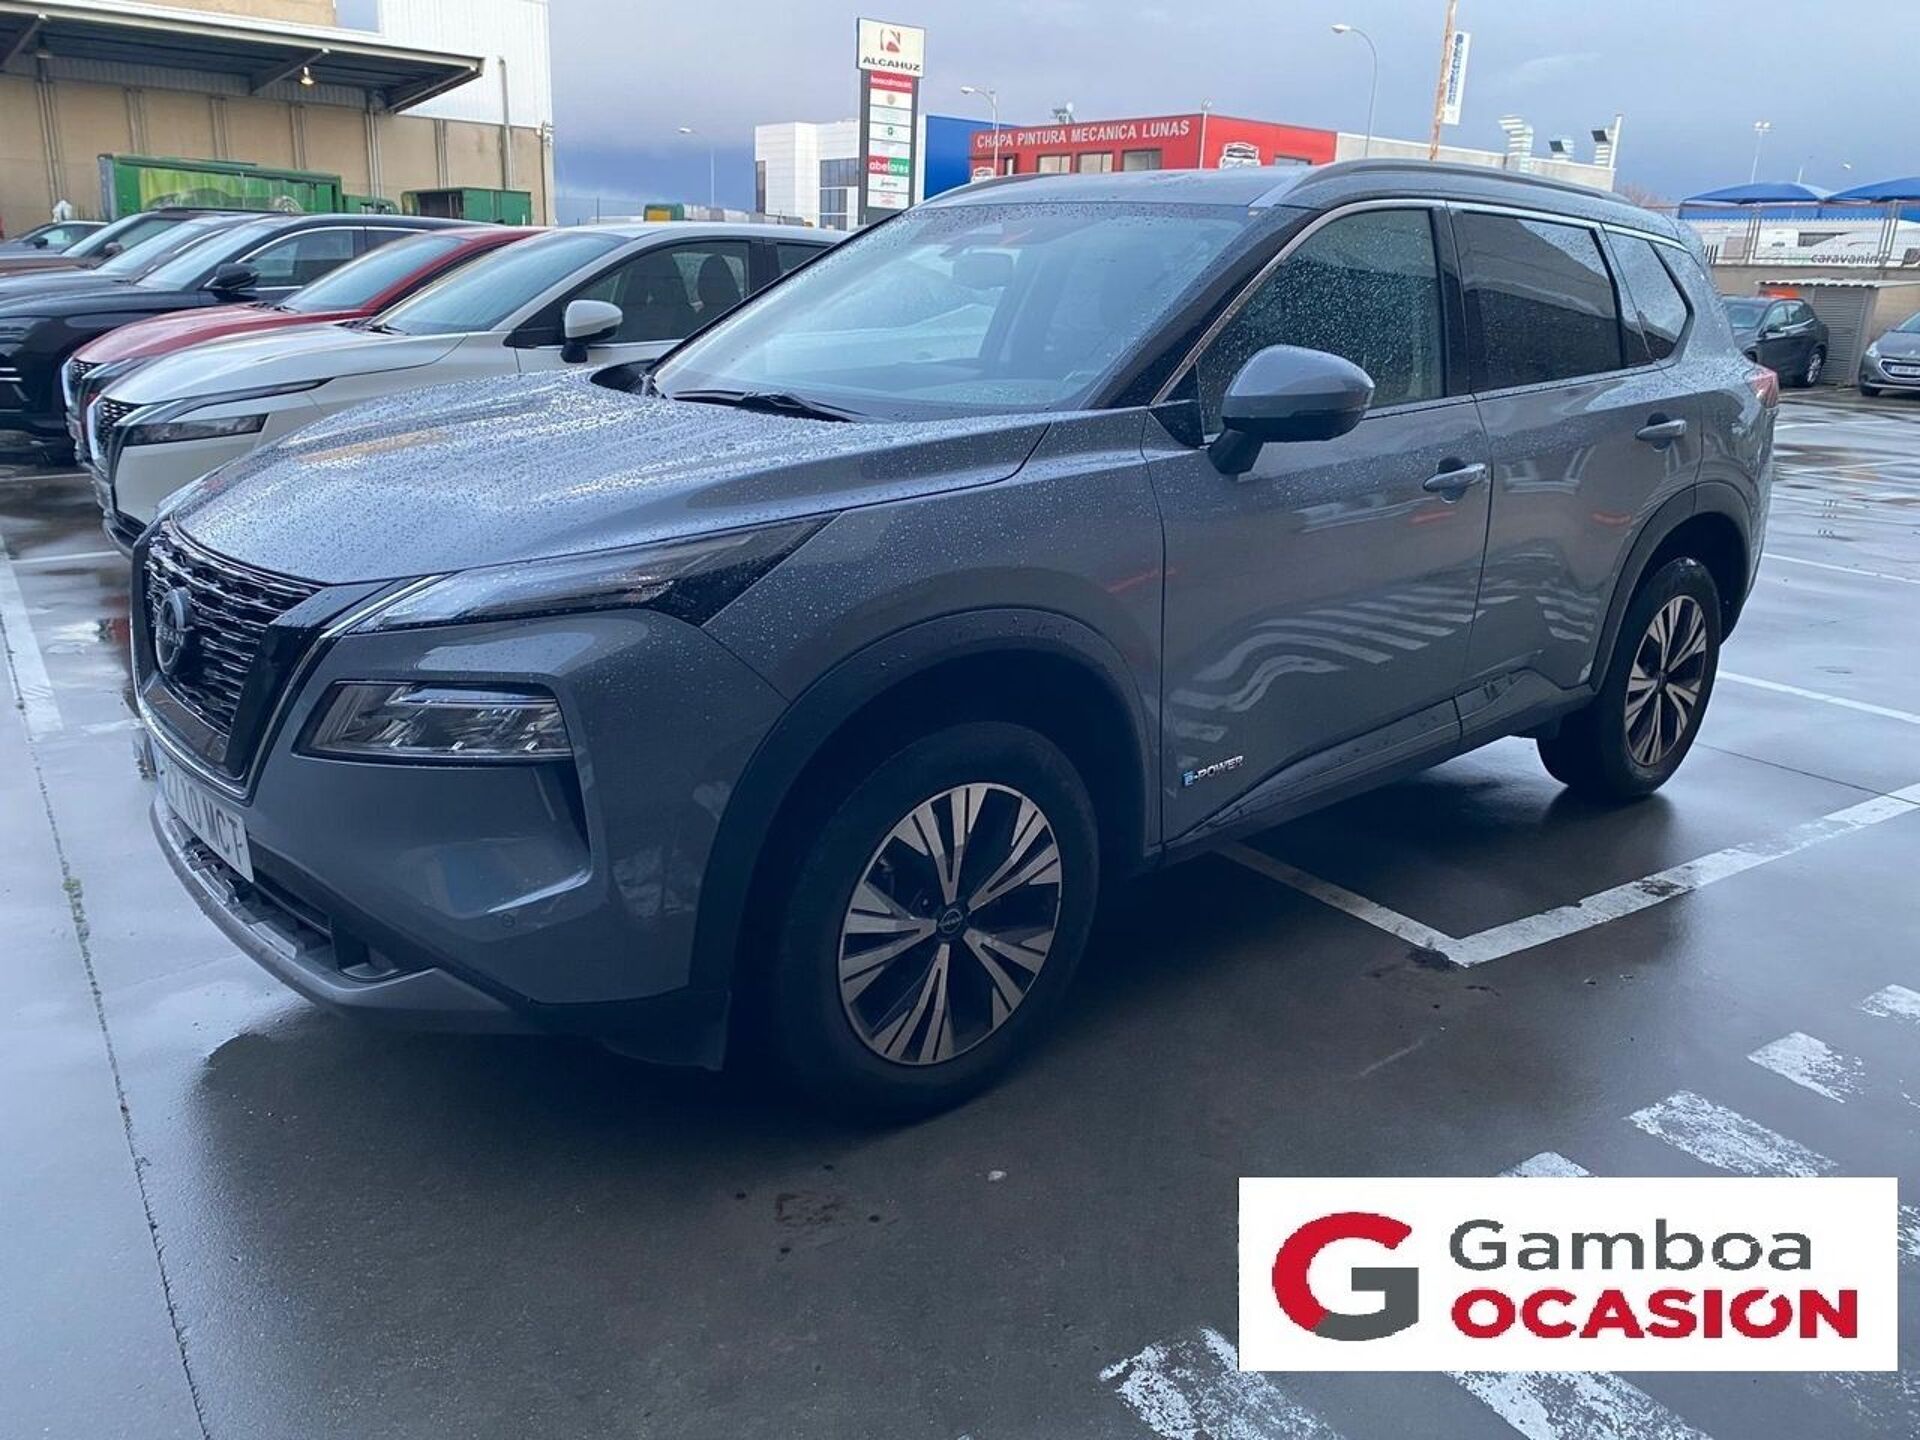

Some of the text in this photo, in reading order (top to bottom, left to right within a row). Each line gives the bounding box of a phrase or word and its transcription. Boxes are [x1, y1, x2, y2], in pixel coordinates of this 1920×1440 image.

[862, 56, 921, 72] ALCAHUZ
[976, 120, 1191, 149] CHAPA PINTURA MECANICA LUNAS
